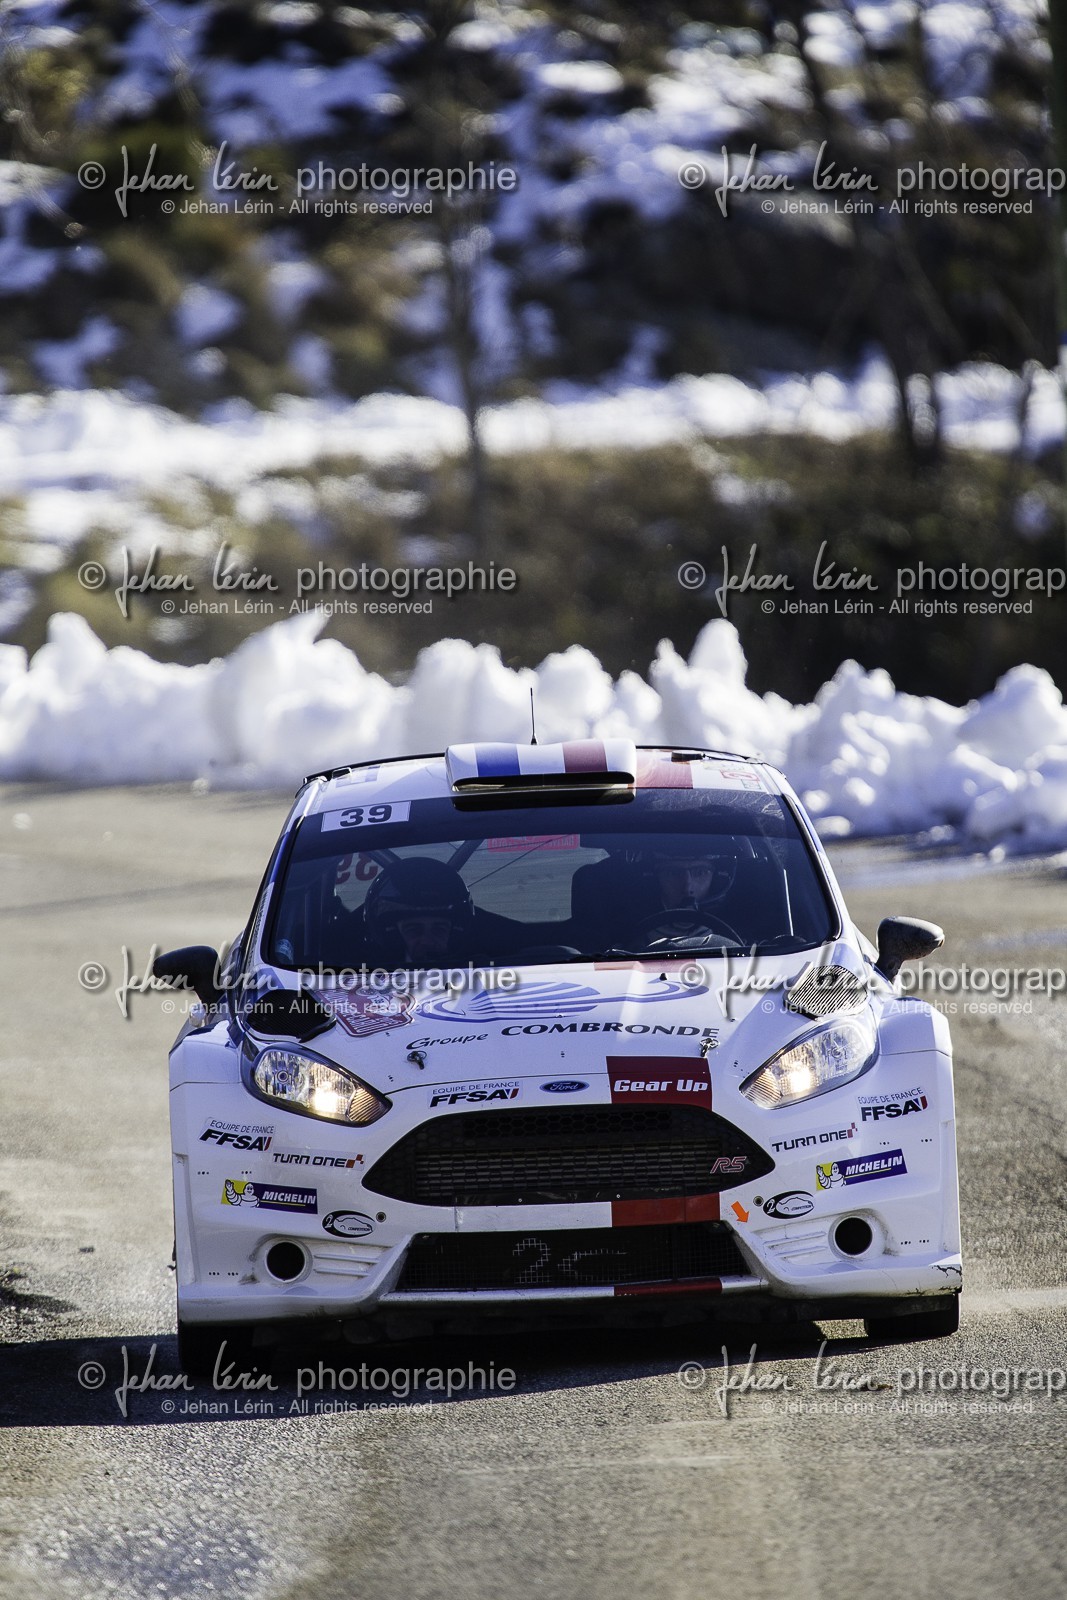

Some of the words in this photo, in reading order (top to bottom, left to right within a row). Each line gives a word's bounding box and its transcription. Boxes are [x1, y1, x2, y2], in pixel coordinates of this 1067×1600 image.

[339, 804, 393, 828] 39
[406, 1033, 489, 1050] Groupe
[501, 1022, 720, 1038] COMBRONDE
[432, 1086, 466, 1095] EQUIPE
[468, 1084, 481, 1092] DE
[483, 1081, 520, 1090] FRANCE
[549, 1082, 579, 1091] Ford
[614, 1080, 672, 1092] Gear
[676, 1079, 709, 1092] Up
[430, 1089, 509, 1107] FFSA
[858, 1096, 880, 1105] EQUIPE
[880, 1095, 891, 1103] DE
[891, 1087, 923, 1101] FRANCE
[861, 1099, 922, 1121] FFSA
[210, 1120, 240, 1132] EQUIPE
[252, 1126, 274, 1134] FRANCE
[199, 1128, 266, 1151] FFSA
[772, 1135, 817, 1152] TURN
[820, 1131, 847, 1143] ONE
[273, 1153, 311, 1164] TURN
[312, 1157, 347, 1167] ONE
[845, 1155, 903, 1175] MICHELIN
[262, 1190, 317, 1204] MICHELIN
